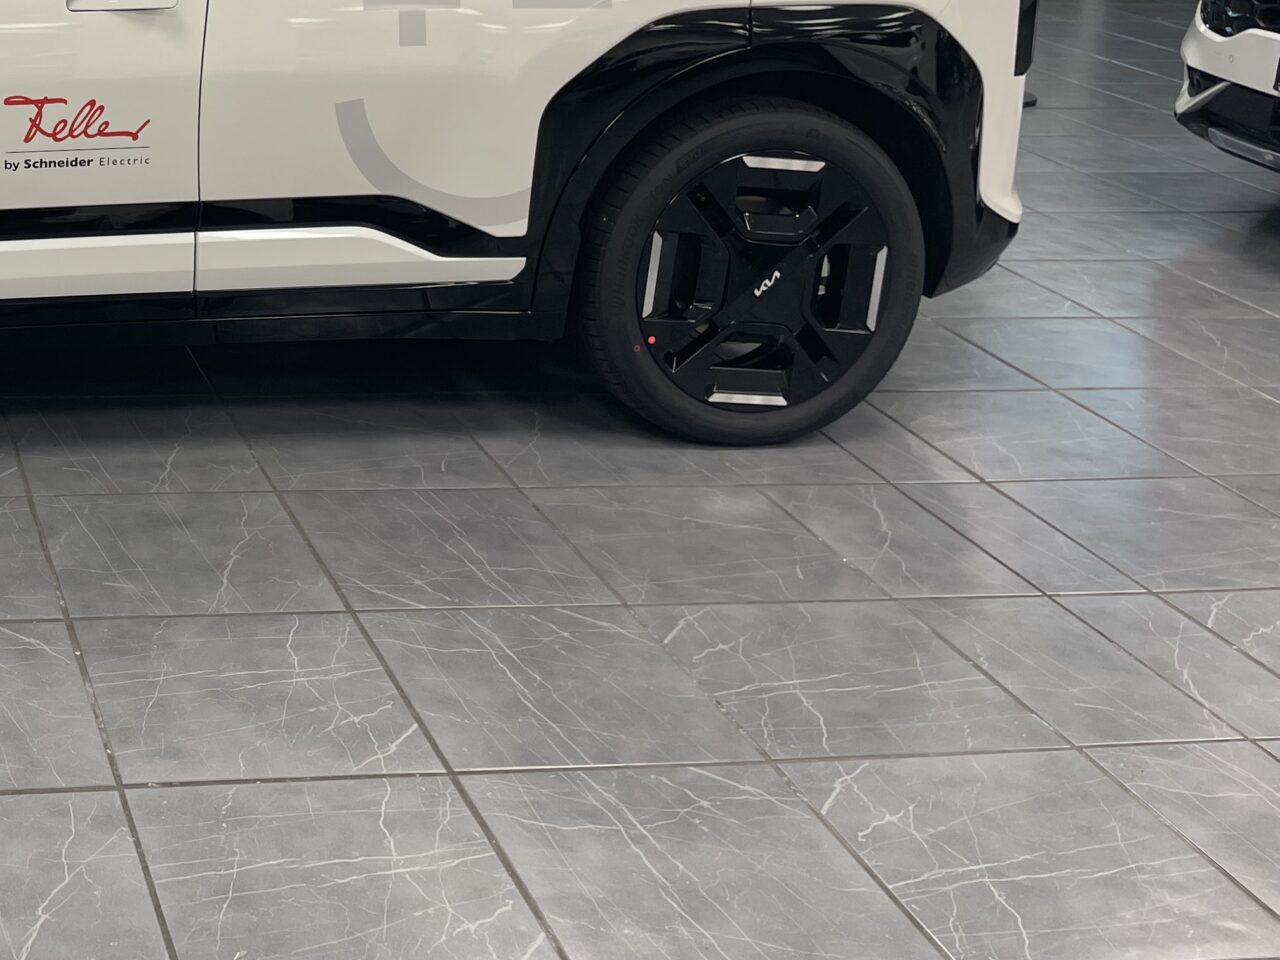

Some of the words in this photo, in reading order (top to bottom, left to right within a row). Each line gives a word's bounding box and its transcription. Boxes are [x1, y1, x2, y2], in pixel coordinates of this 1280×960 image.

[3, 95, 151, 143] Feller
[4, 159, 20, 171] by
[23, 157, 94, 169] Schneider
[99, 156, 150, 167] Electric
